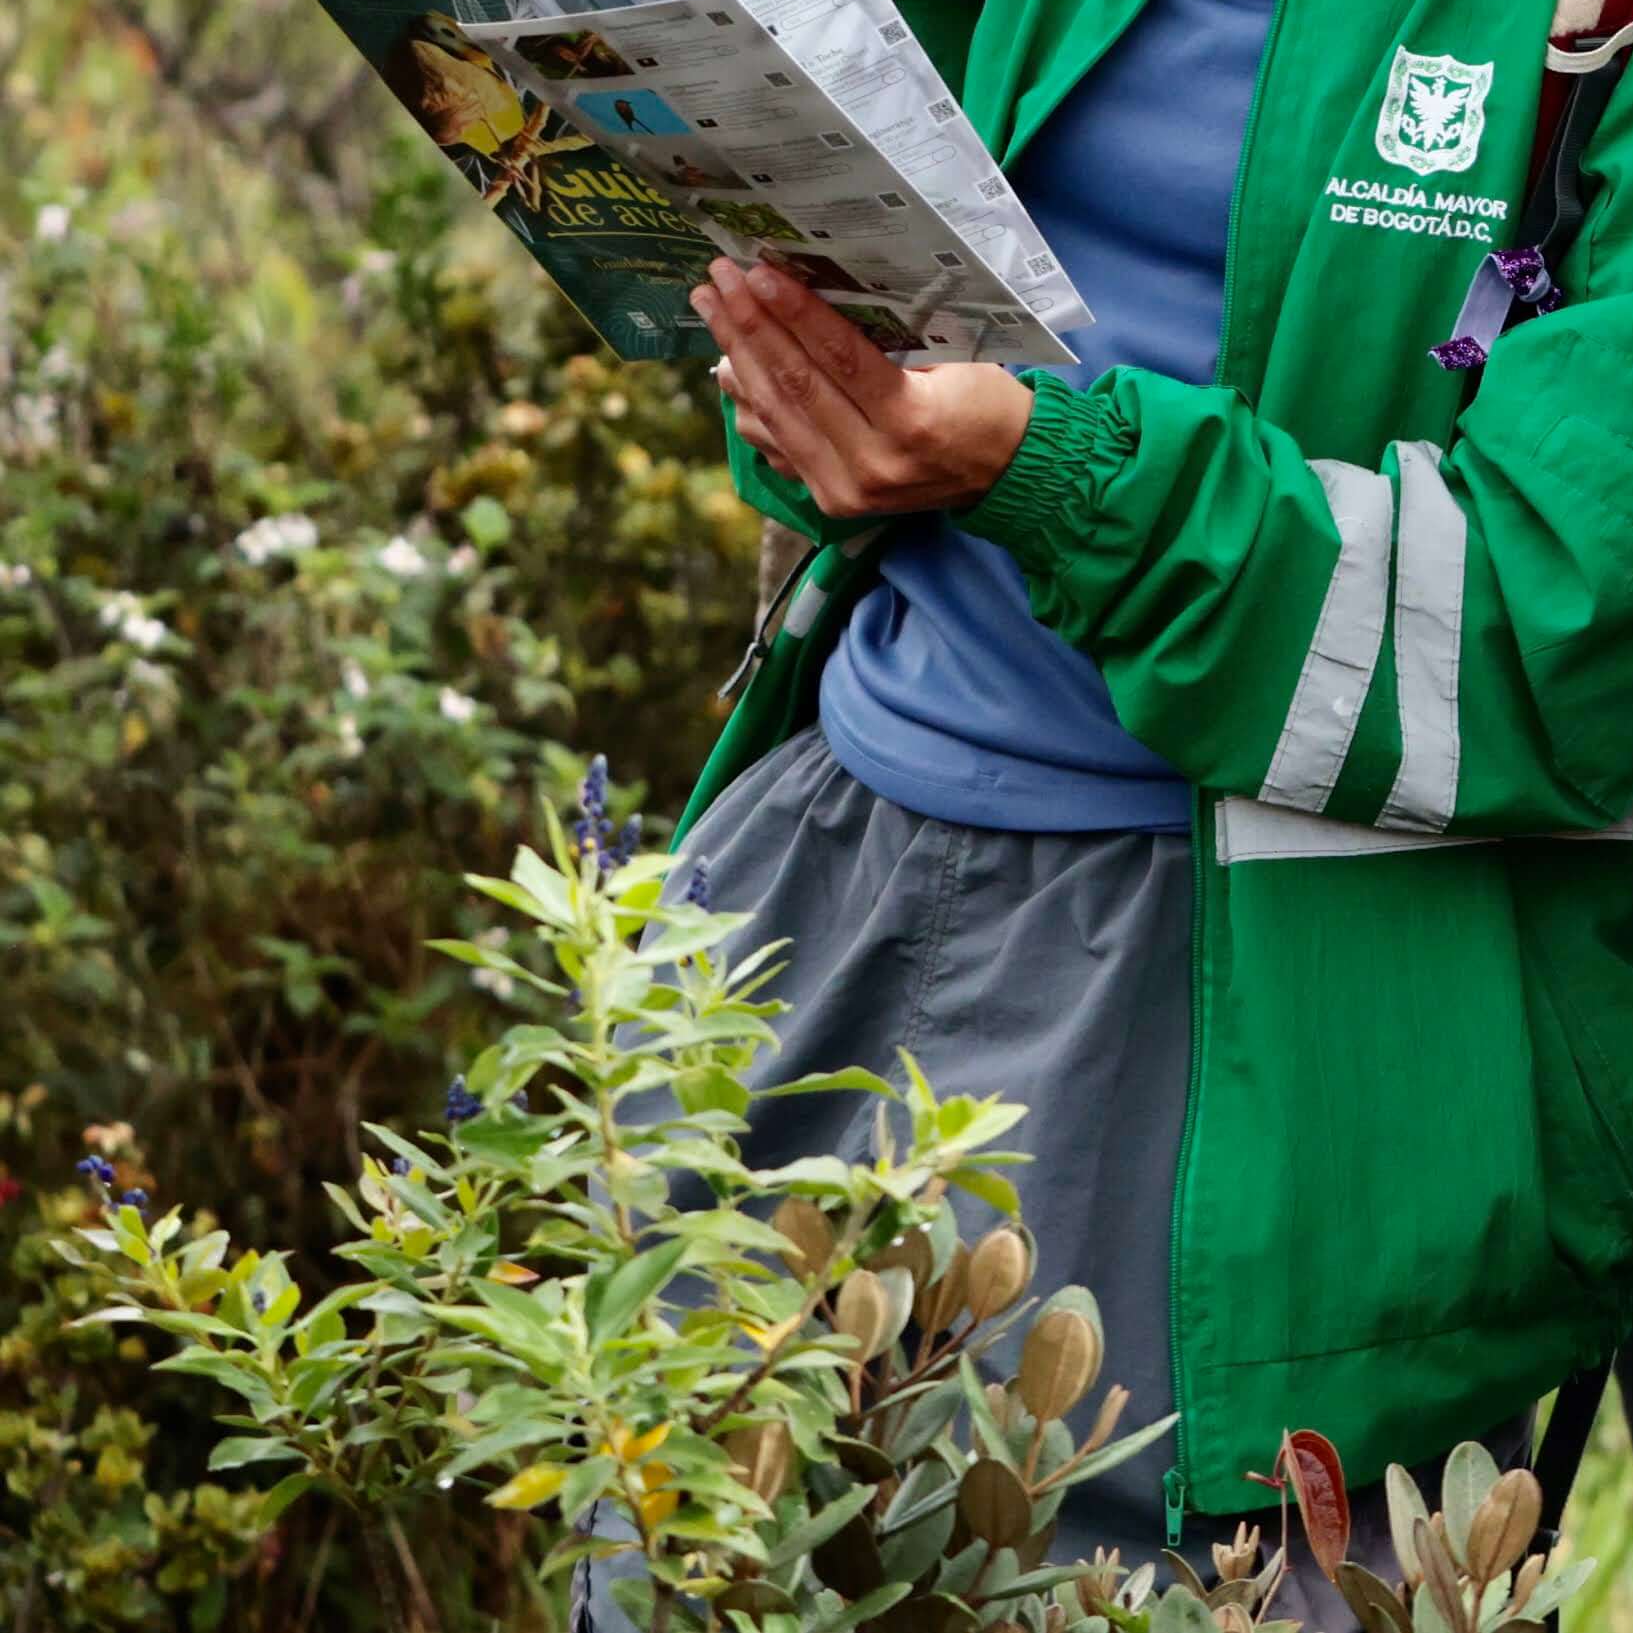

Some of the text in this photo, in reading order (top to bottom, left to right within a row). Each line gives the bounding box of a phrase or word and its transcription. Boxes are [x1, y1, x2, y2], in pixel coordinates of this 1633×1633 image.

[547, 191, 604, 226] de
[1324, 177, 1508, 219] ALCALDÍA MAYOR
[1329, 203, 1493, 243] DE BOGOTÁ D.C.
